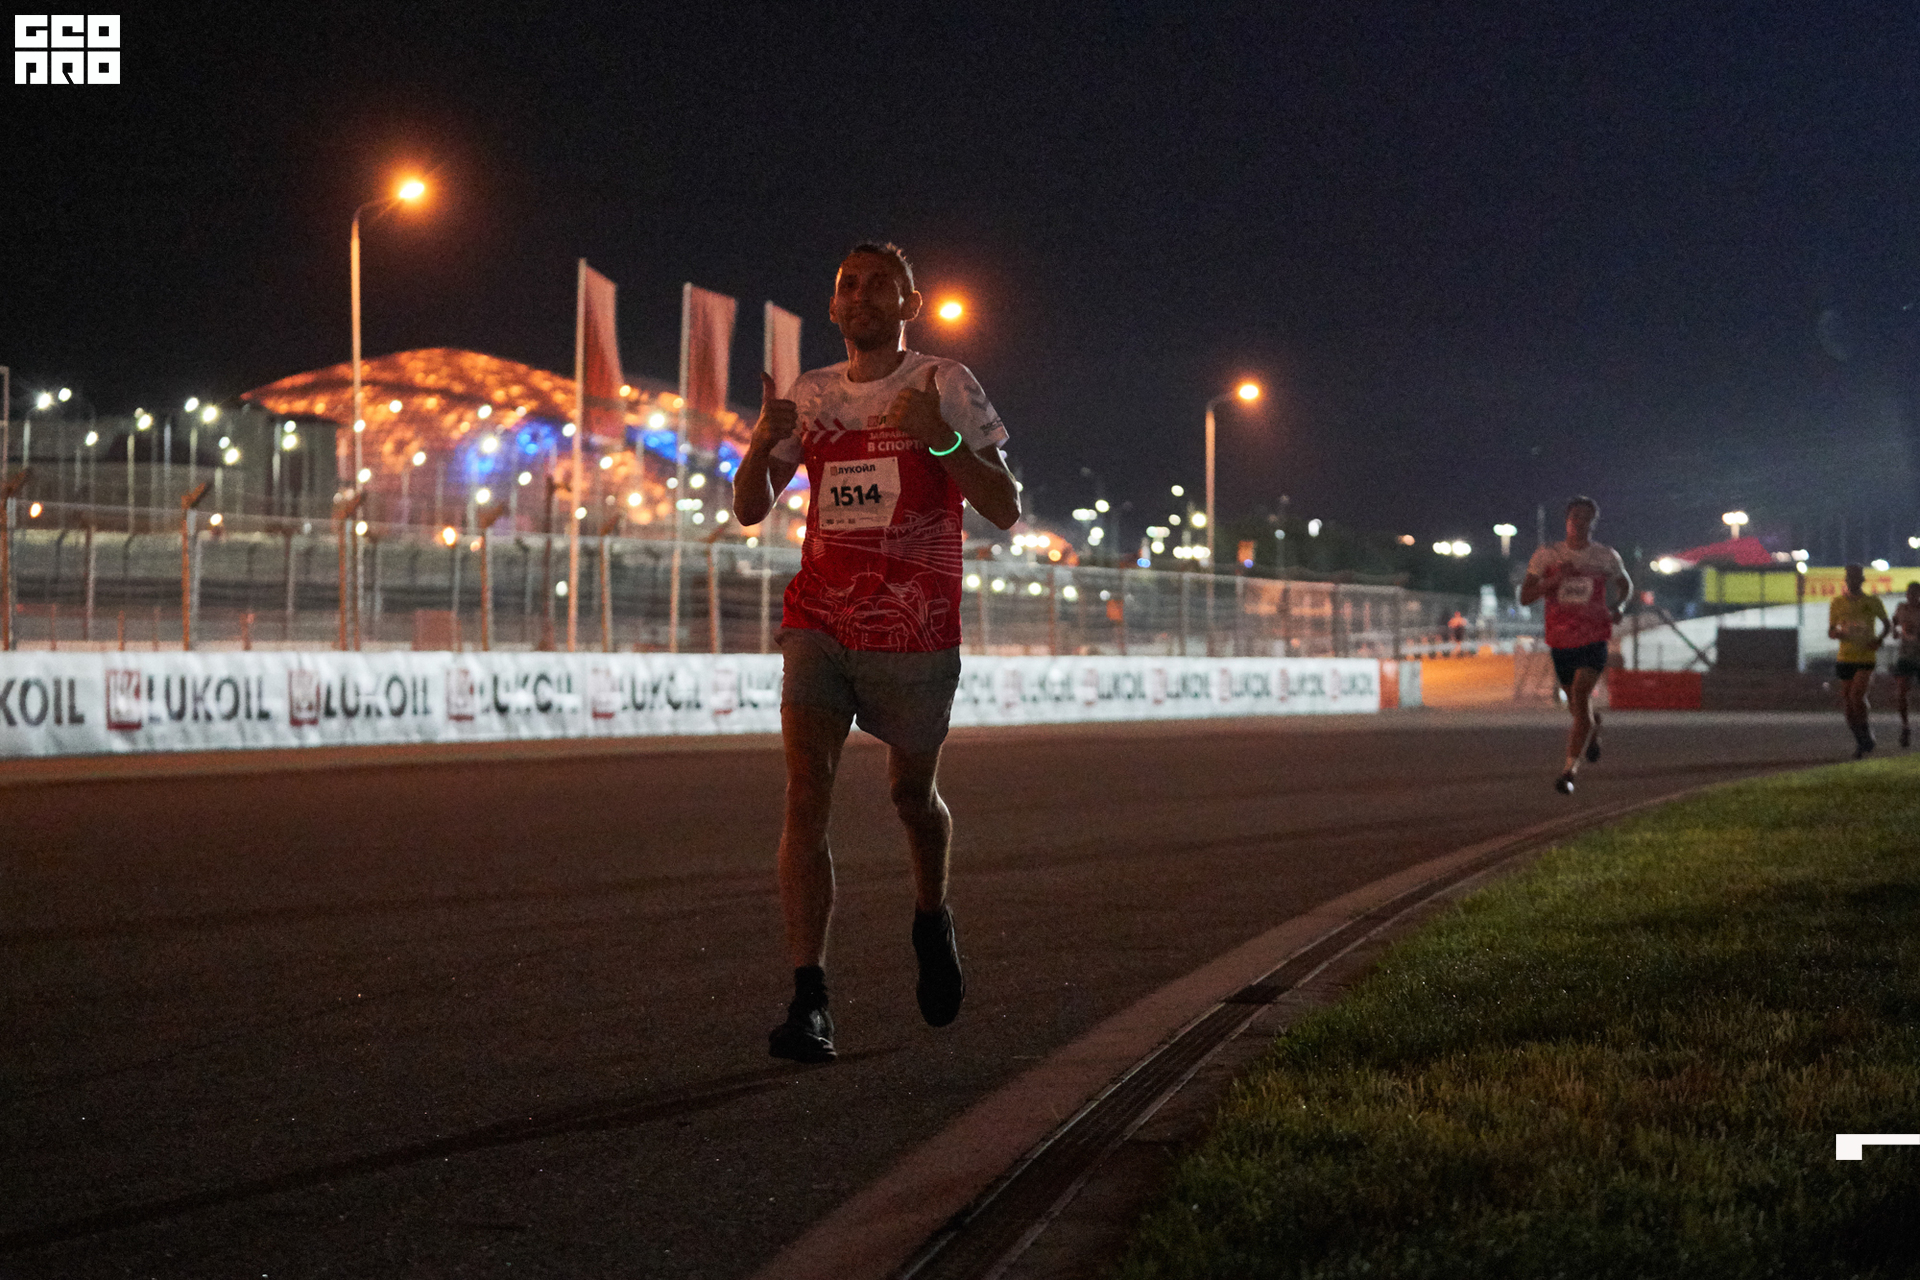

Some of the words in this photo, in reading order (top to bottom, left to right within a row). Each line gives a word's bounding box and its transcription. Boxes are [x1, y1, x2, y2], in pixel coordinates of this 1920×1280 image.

[838, 464, 876, 474] ЛУКОЙЛ
[830, 484, 882, 506] 1514
[147, 675, 271, 723] LUKOIL
